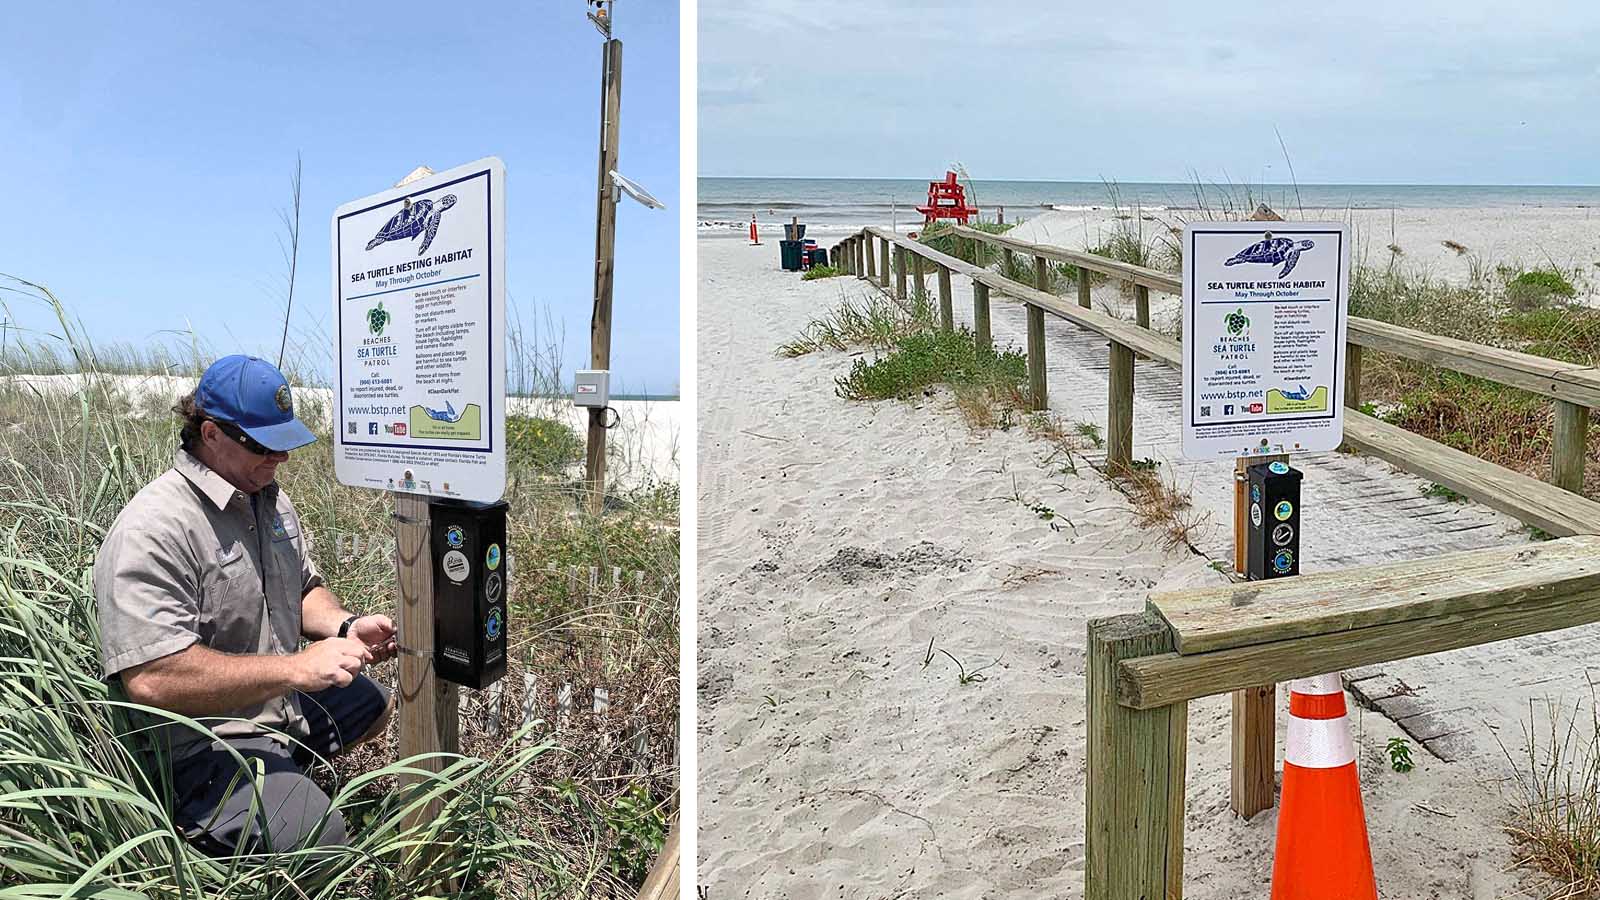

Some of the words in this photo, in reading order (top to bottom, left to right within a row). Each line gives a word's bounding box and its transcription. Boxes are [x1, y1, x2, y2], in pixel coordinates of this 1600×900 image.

[352, 274, 366, 283] SEA
[367, 266, 394, 280] TURTLE
[396, 258, 432, 273] NESTING
[434, 248, 472, 265] HABITAT
[376, 278, 388, 288] May
[390, 274, 415, 286] Through
[416, 269, 441, 280] October
[1208, 282, 1224, 290] SEA
[1226, 282, 1254, 290] TURTLE
[1256, 281, 1291, 289] NESTING
[1293, 280, 1326, 288] HABITAT
[1250, 290, 1274, 298] Through
[363, 336, 391, 346] BEACHES
[357, 348, 370, 358] SEA
[372, 345, 396, 358] TURTLE
[1213, 345, 1226, 353] SEA
[1230, 344, 1256, 352] TURTLE
[1200, 390, 1263, 400] www.bstp.net
[348, 404, 406, 416] www.bstp.net
[1240, 403, 1264, 414] YouTube
